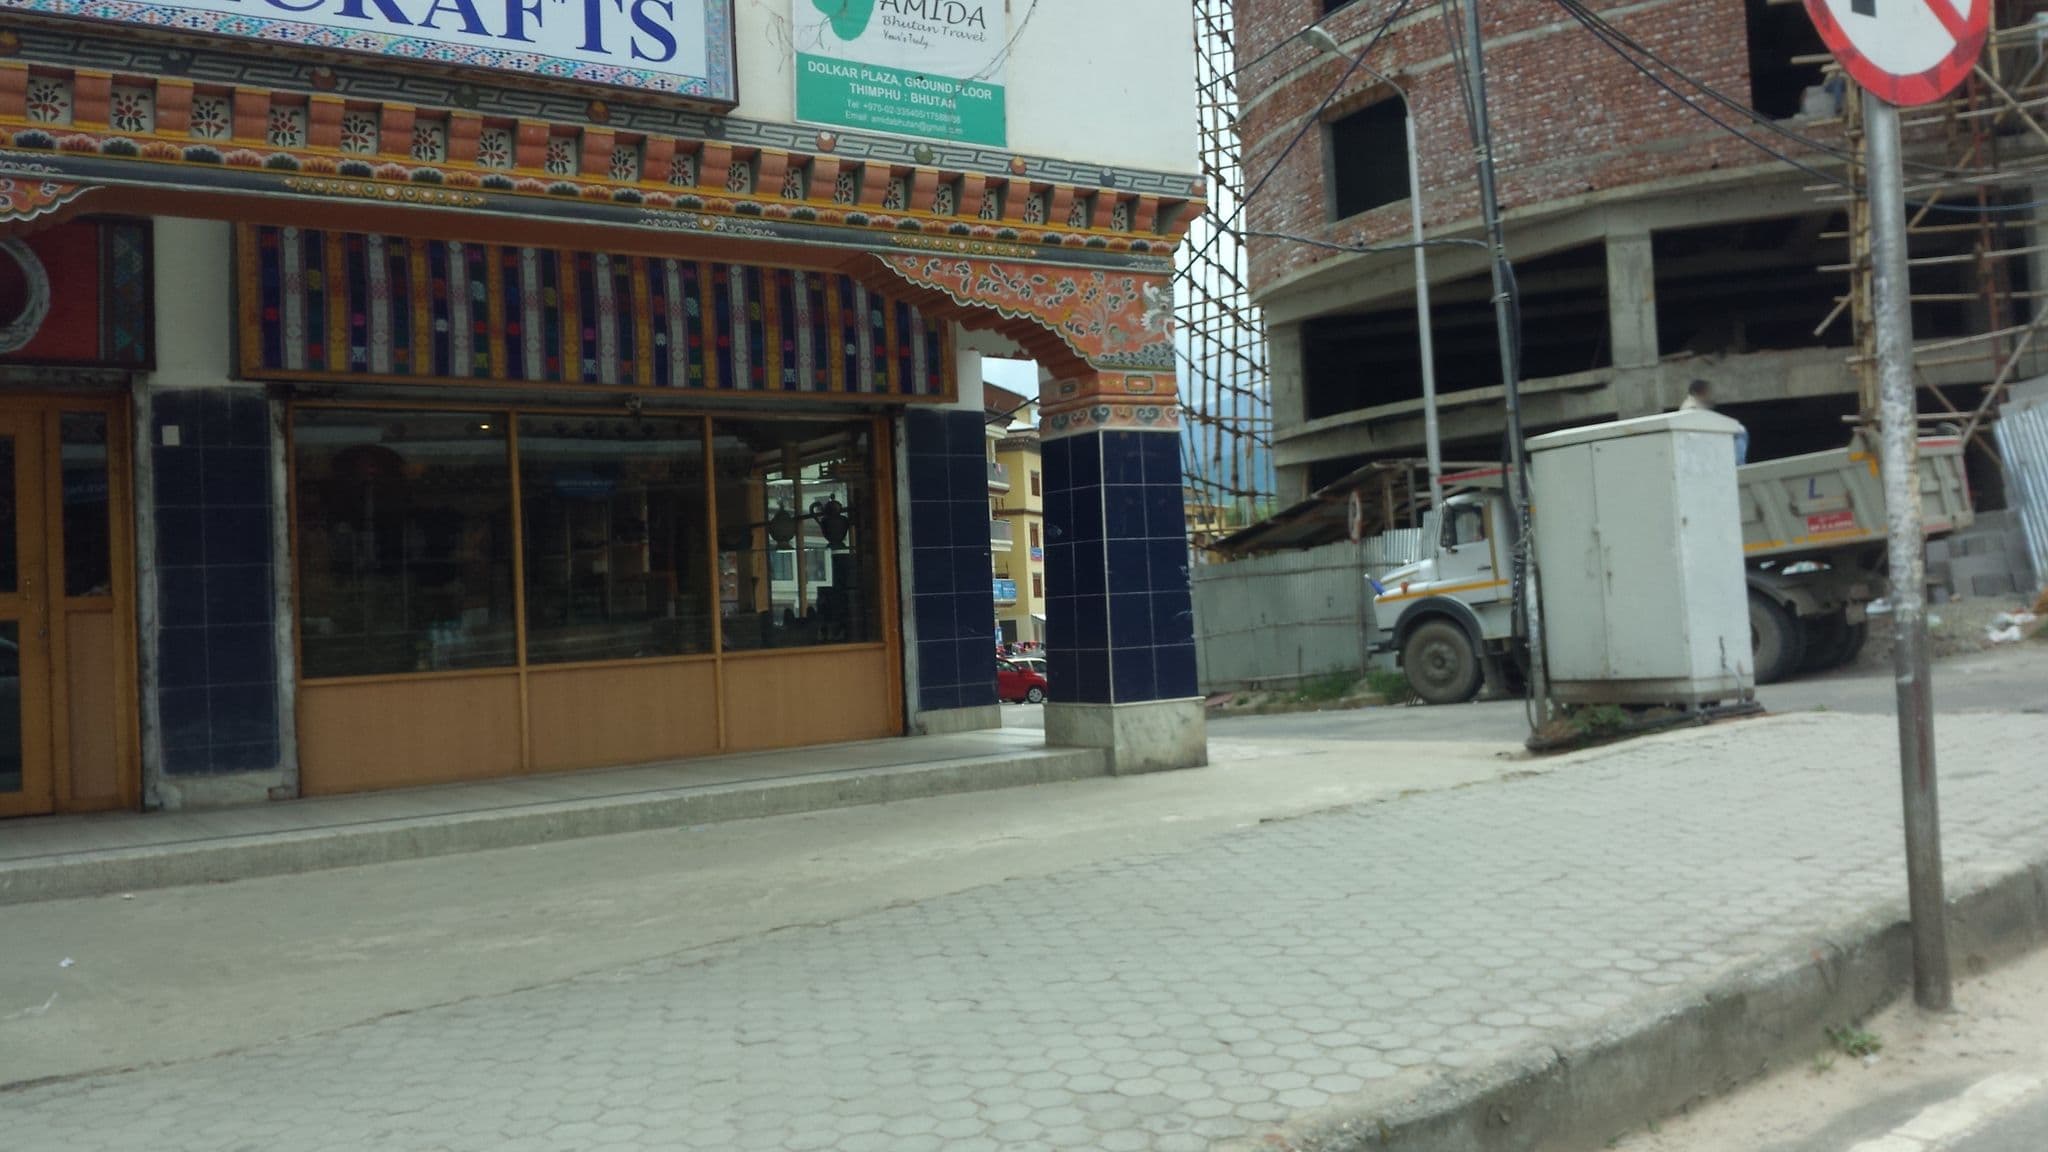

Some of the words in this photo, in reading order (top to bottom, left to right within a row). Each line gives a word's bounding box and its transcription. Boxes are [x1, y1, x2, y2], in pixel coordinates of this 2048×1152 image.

[880, 0, 986, 29] AMIDA
[882, 15, 938, 34] Bhutan
[941, 26, 985, 42] Travel
[807, 60, 858, 79] DOLKAR
[904, 77, 953, 95] GROUND
[955, 85, 993, 101] FLOOR
[849, 83, 901, 101] THIMPHU
[911, 93, 957, 110] BHUTAN
